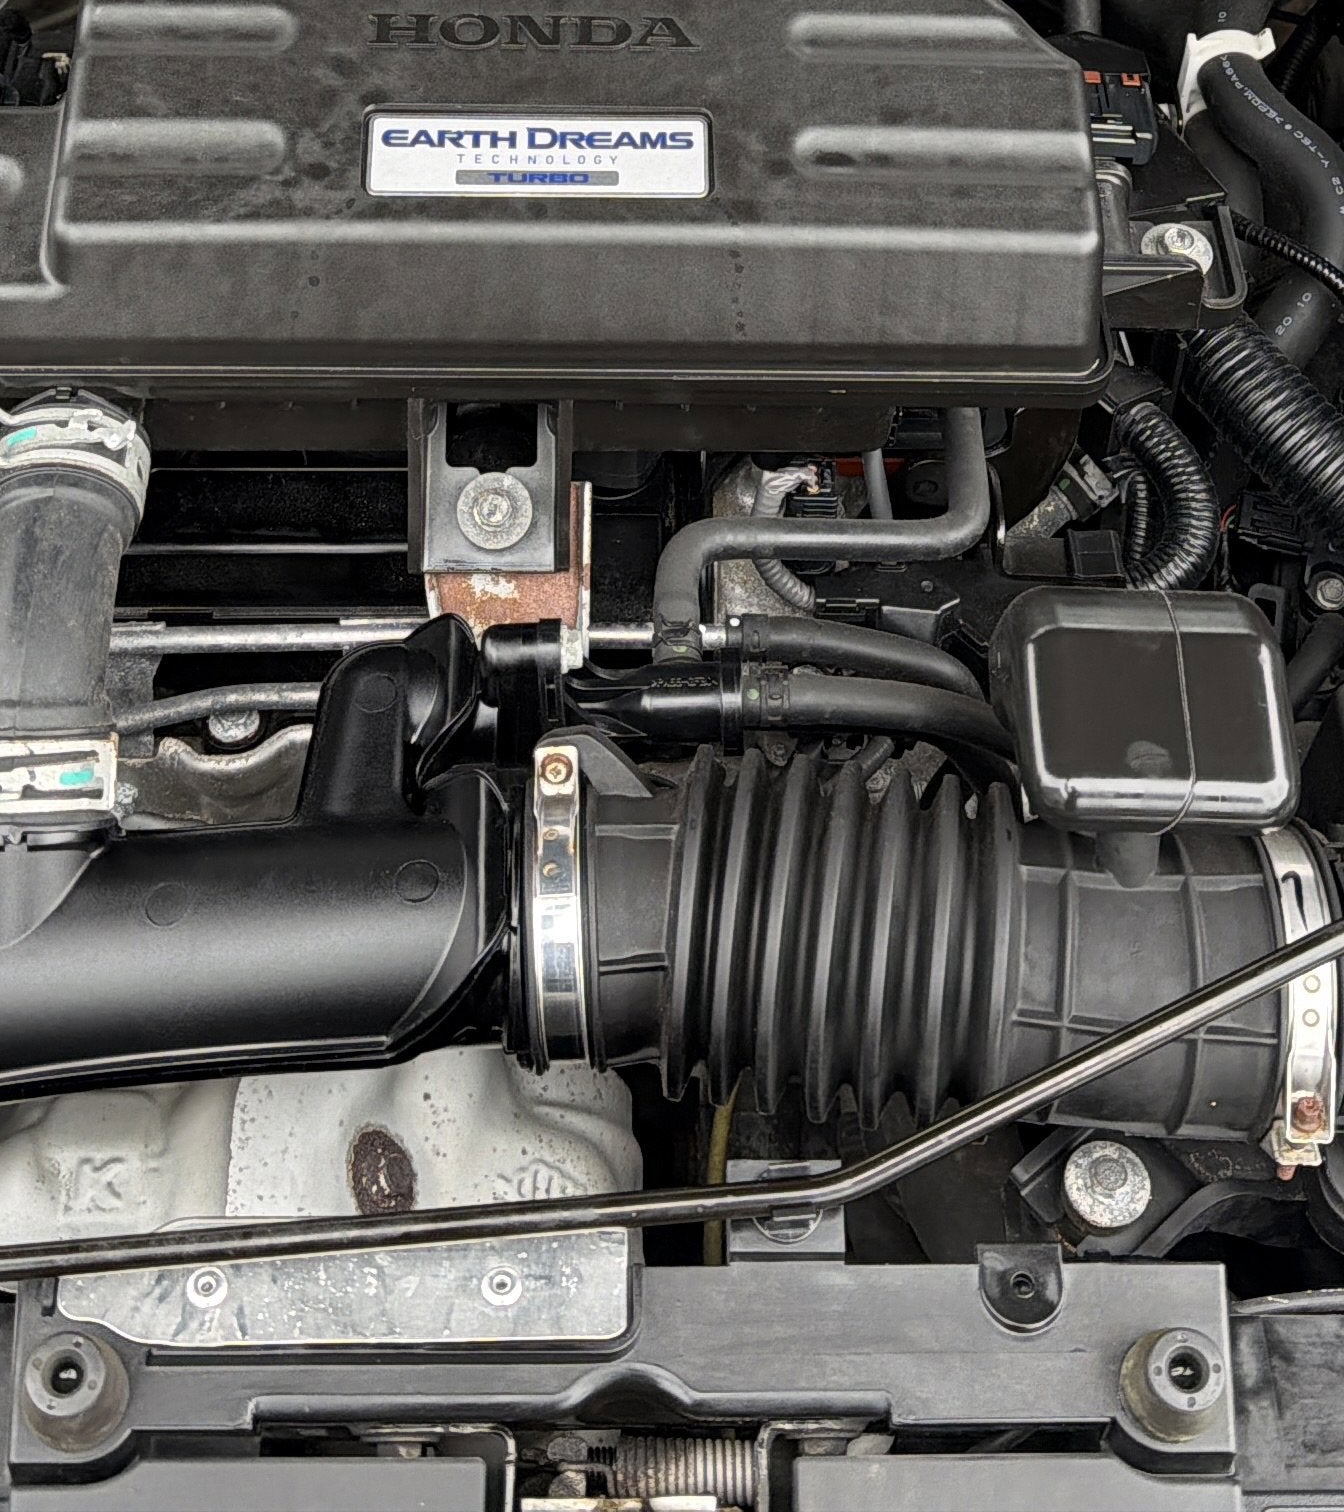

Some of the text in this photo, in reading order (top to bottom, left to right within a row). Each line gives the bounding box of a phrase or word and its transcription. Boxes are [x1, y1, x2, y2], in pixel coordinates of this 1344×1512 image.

[367, 13, 702, 52] HONDA
[381, 125, 695, 150] EARTH DREAMS
[1293, 130, 1331, 169] Y-TEC
[456, 153, 620, 165] TECHNOLOGY
[486, 172, 590, 184] TURBO
[1274, 291, 1313, 336] 20 10
